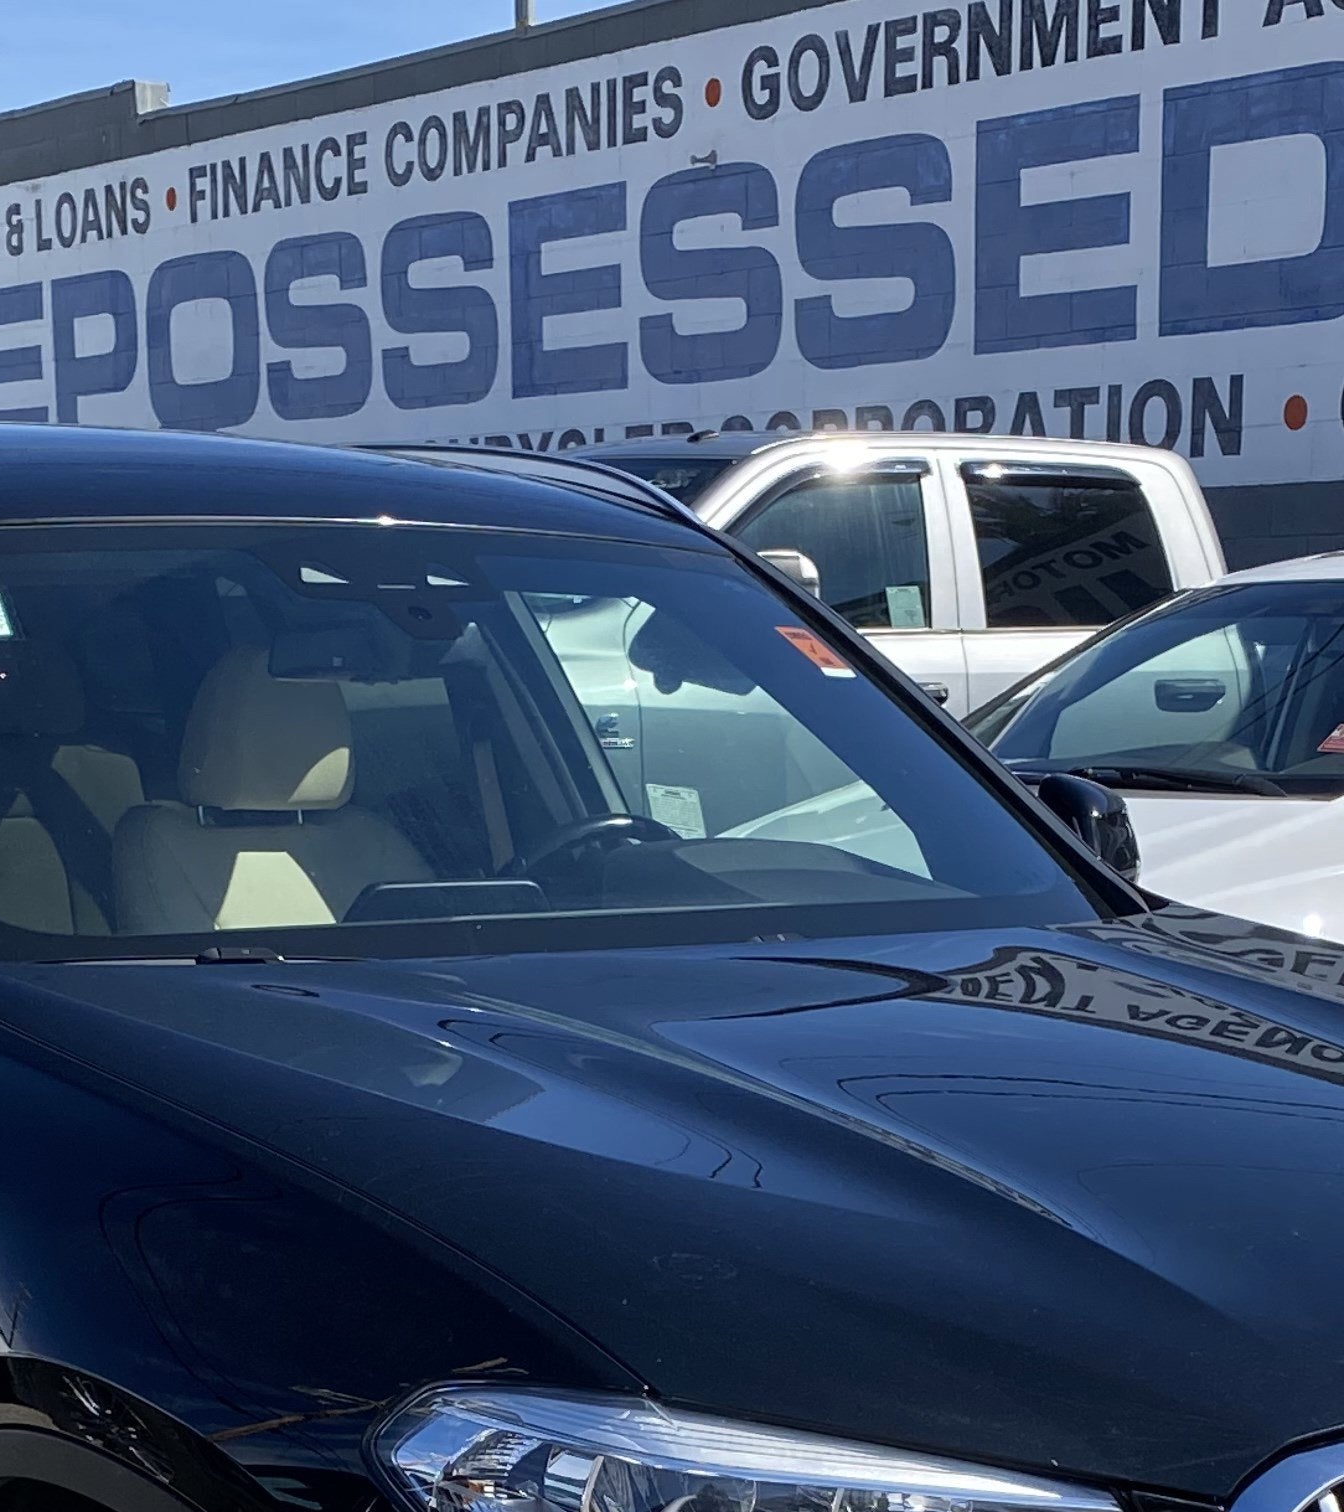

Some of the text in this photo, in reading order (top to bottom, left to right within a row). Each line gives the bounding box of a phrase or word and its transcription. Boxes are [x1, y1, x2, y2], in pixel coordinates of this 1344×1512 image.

[5, 202, 24, 257] &
[36, 176, 151, 252] LOANS
[188, 131, 369, 224] FINANCE
[384, 66, 684, 187] COMPANIES
